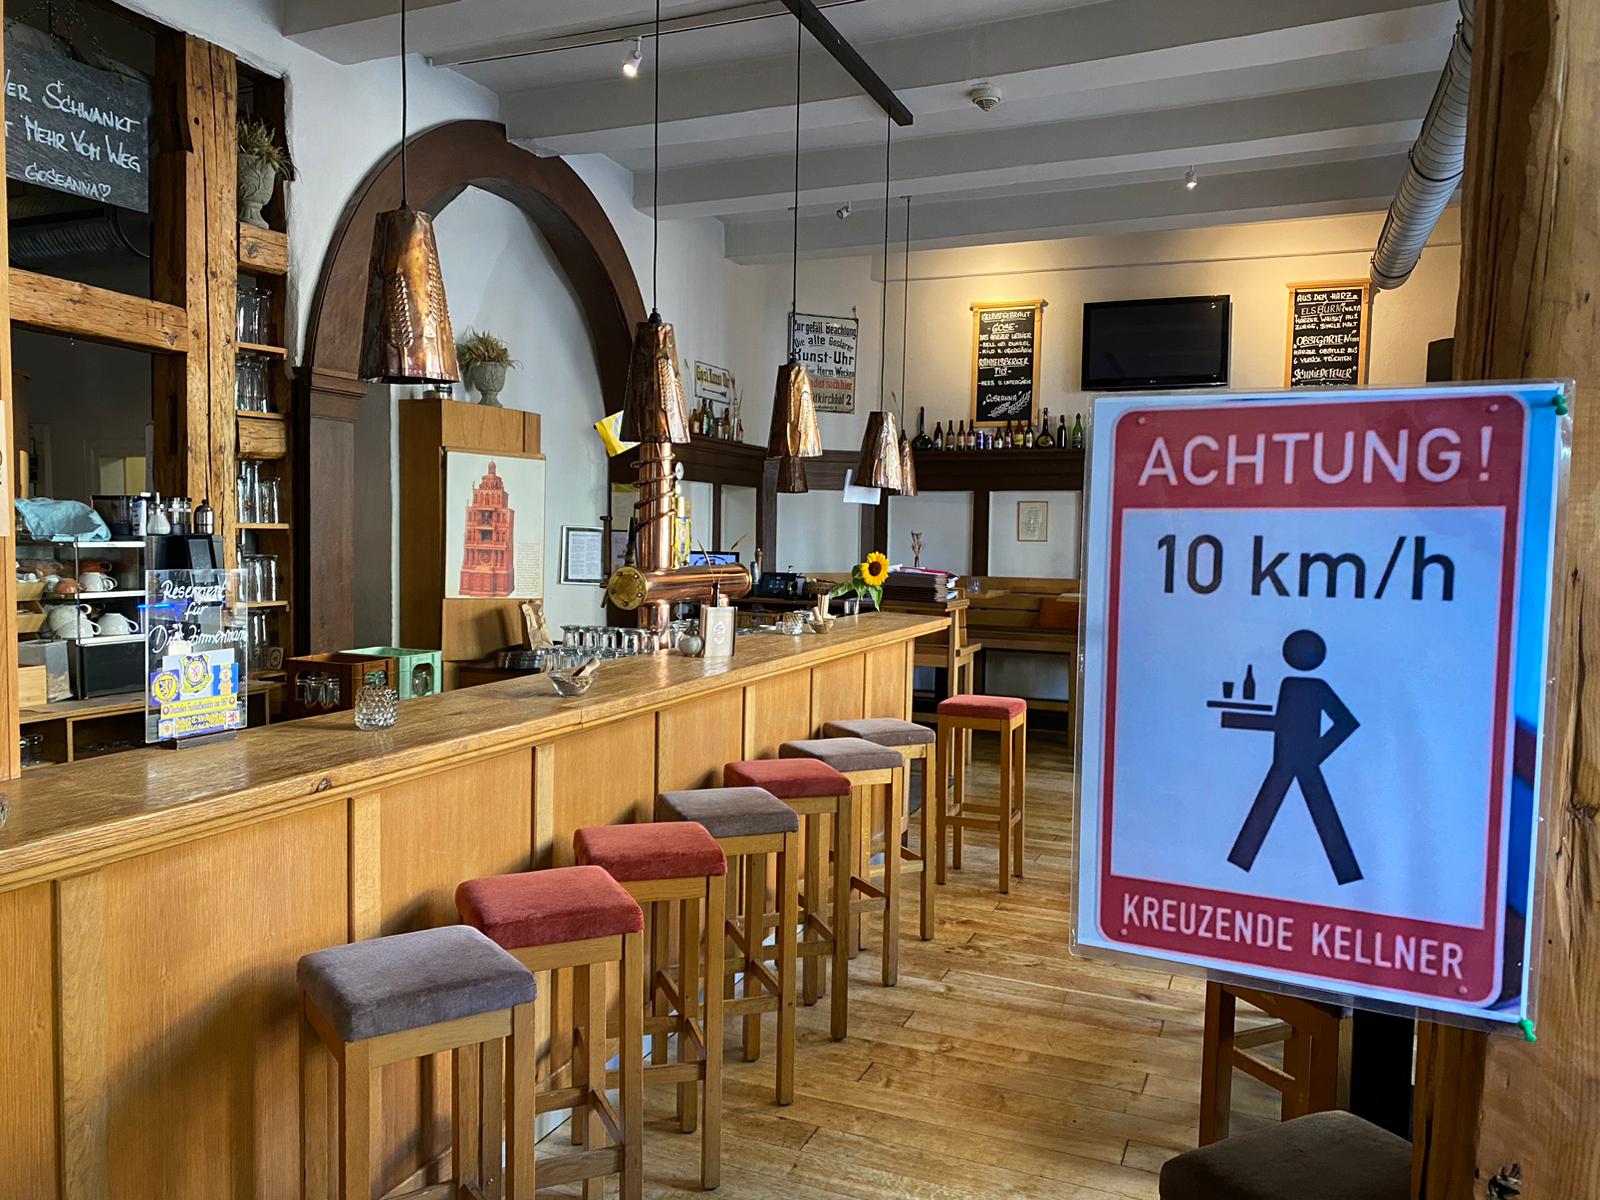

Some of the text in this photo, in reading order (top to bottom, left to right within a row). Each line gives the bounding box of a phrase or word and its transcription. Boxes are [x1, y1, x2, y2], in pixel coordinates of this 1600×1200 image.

[4, 69, 31, 103] ER
[22, 115, 68, 152] MEHR
[71, 130, 100, 161] VOM
[105, 135, 141, 173] WEG
[1297, 294, 1311, 302] AUS
[1314, 293, 1328, 301] DEM
[794, 348, 855, 365] Kunst-Uhr
[808, 334, 825, 345] alte
[828, 336, 854, 352] Goslarer
[845, 394, 852, 405] 2
[1137, 425, 1492, 487] ACHTUNG!
[1157, 533, 1455, 601] 10 km/h
[184, 600, 208, 621] für
[1121, 893, 1464, 981] KREUZENDE KELLNER
